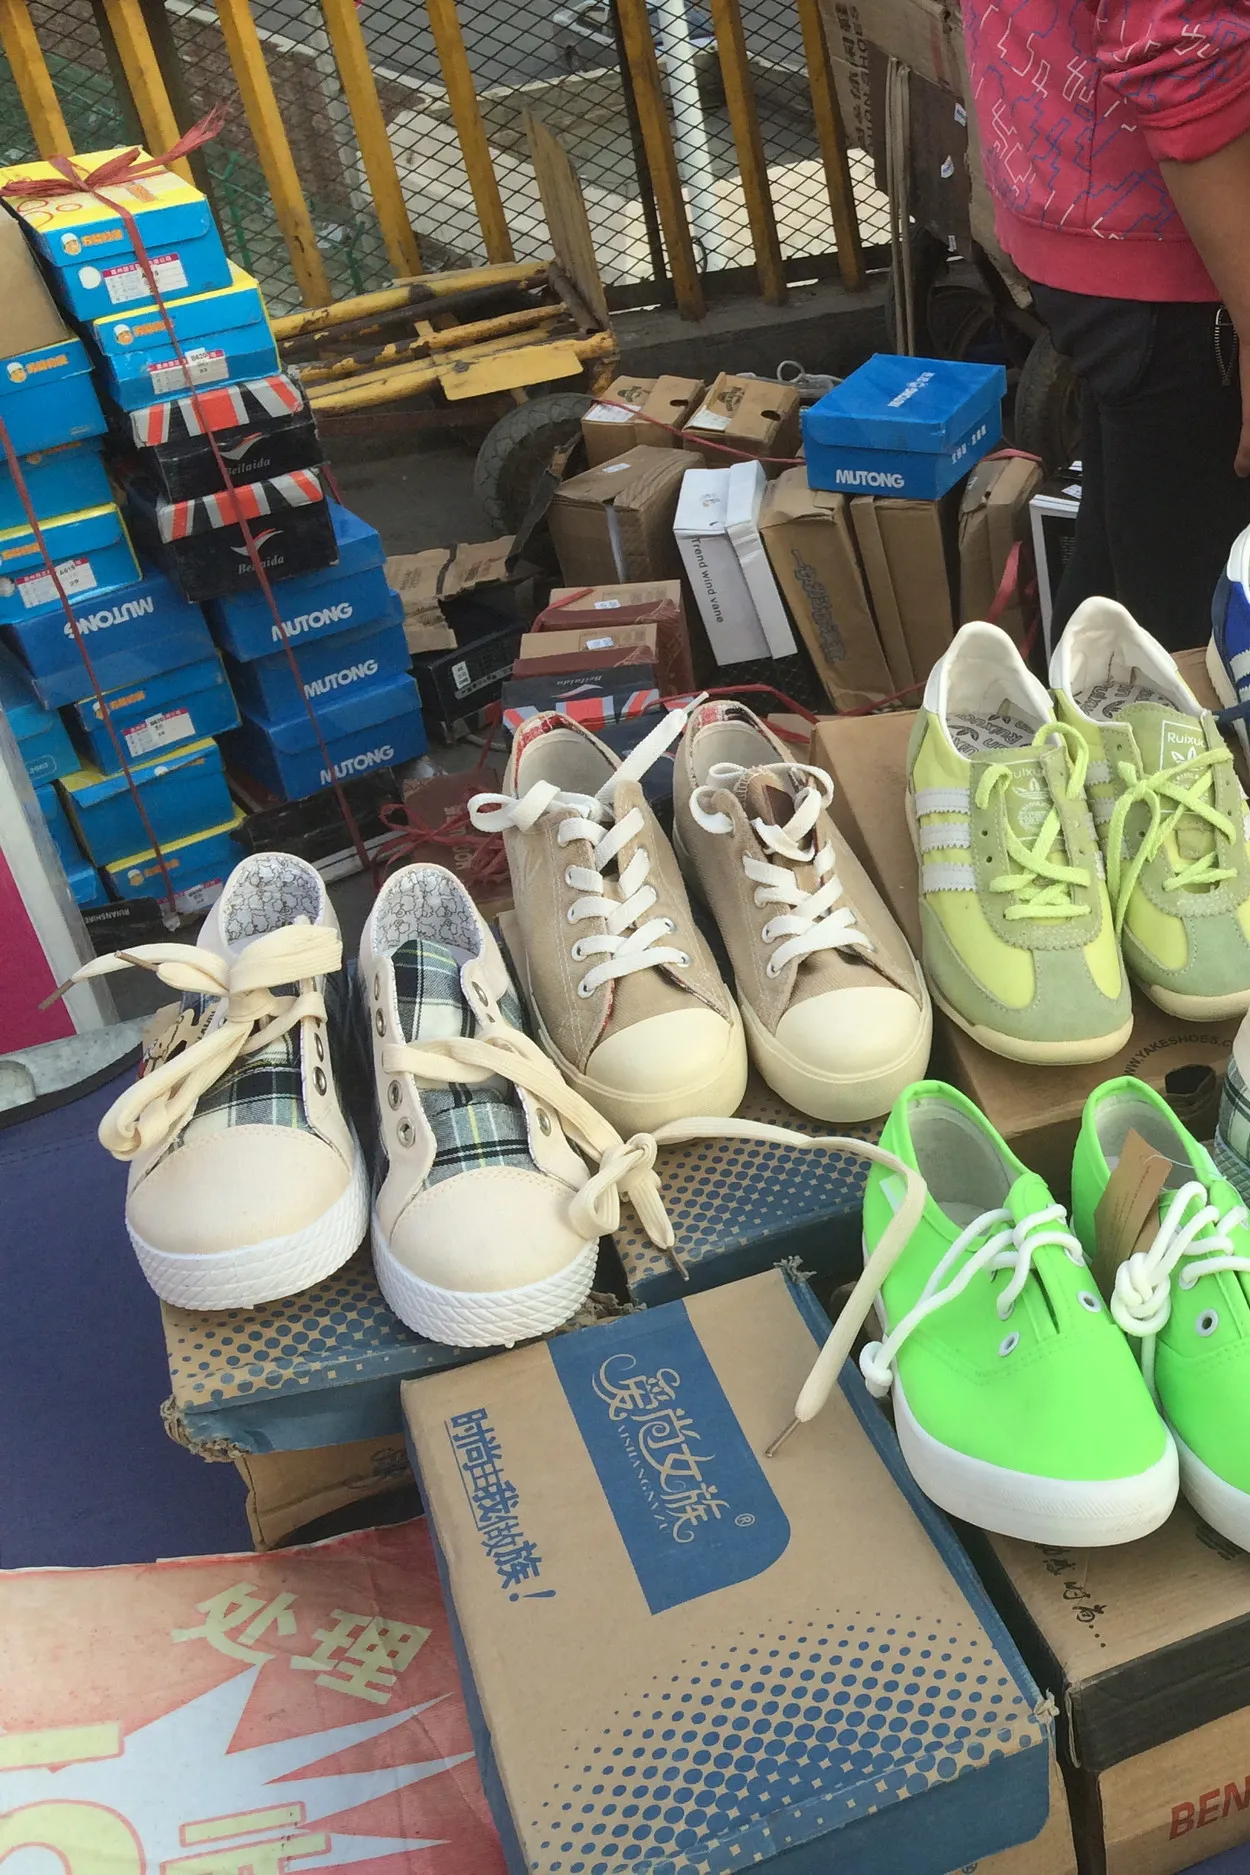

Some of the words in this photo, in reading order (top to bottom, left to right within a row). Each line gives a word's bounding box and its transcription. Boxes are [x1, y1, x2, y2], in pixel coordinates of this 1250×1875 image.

[835, 469, 905, 489] MUTONG
[238, 555, 285, 575] Beaida
[691, 537, 708, 569] Trend
[702, 569, 717, 595] wind
[711, 597, 724, 623] vane
[64, 596, 154, 639] MUTONG
[271, 602, 353, 642] MUTONG
[303, 659, 379, 699] MUTONG
[320, 745, 395, 785] MUTONG
[171, 1581, 434, 1706] 处理
